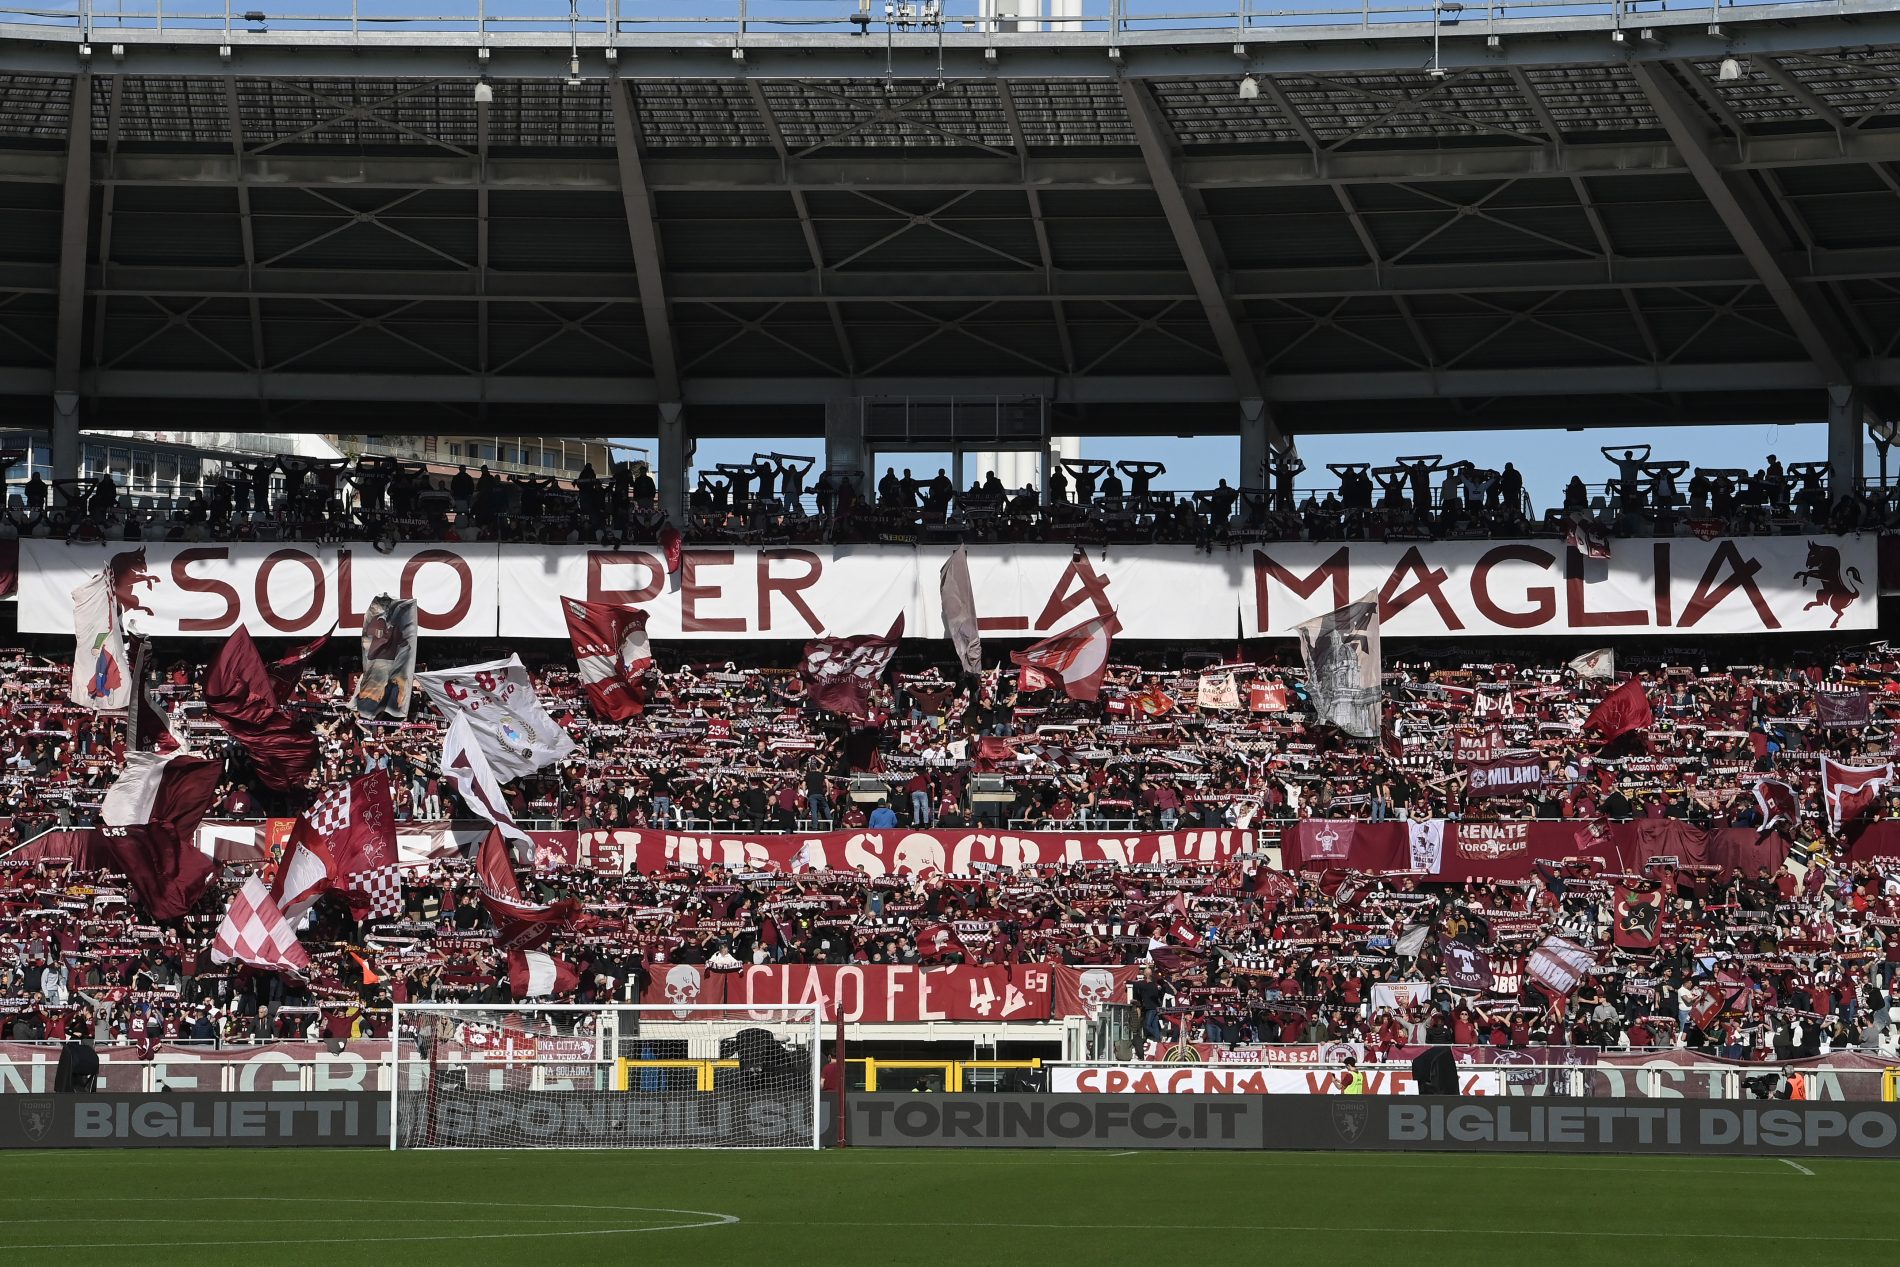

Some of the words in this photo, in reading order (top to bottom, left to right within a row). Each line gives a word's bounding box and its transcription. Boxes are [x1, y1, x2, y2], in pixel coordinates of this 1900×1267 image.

[170, 547, 472, 633] SOLO
[586, 549, 827, 636] PER
[1252, 539, 1781, 632] MAGLIA
[708, 724, 730, 736] 25%
[1459, 736, 1487, 748] MAI
[1456, 750, 1490, 761] SOLI
[1487, 765, 1540, 786] MILANO
[1457, 823, 1527, 839] RENATE
[1459, 842, 1486, 852] TORO
[1499, 841, 1527, 852] CLUB
[1476, 909, 1485, 917] LA
[1486, 909, 1519, 918] MARATONA
[435, 940, 452, 949] ULT
[462, 941, 482, 949] RAS
[747, 964, 864, 1023] CIAO
[1024, 969, 1048, 993] 69
[1221, 1051, 1248, 1059] PRIMO
[1268, 1049, 1318, 1063] BASSA
[73, 1101, 359, 1138] BIGLIETTI
[856, 1100, 1248, 1140] TORINOFC.IT
[1387, 1105, 1681, 1144] BIGLIETTI
[1699, 1110, 1898, 1149] DISPO
